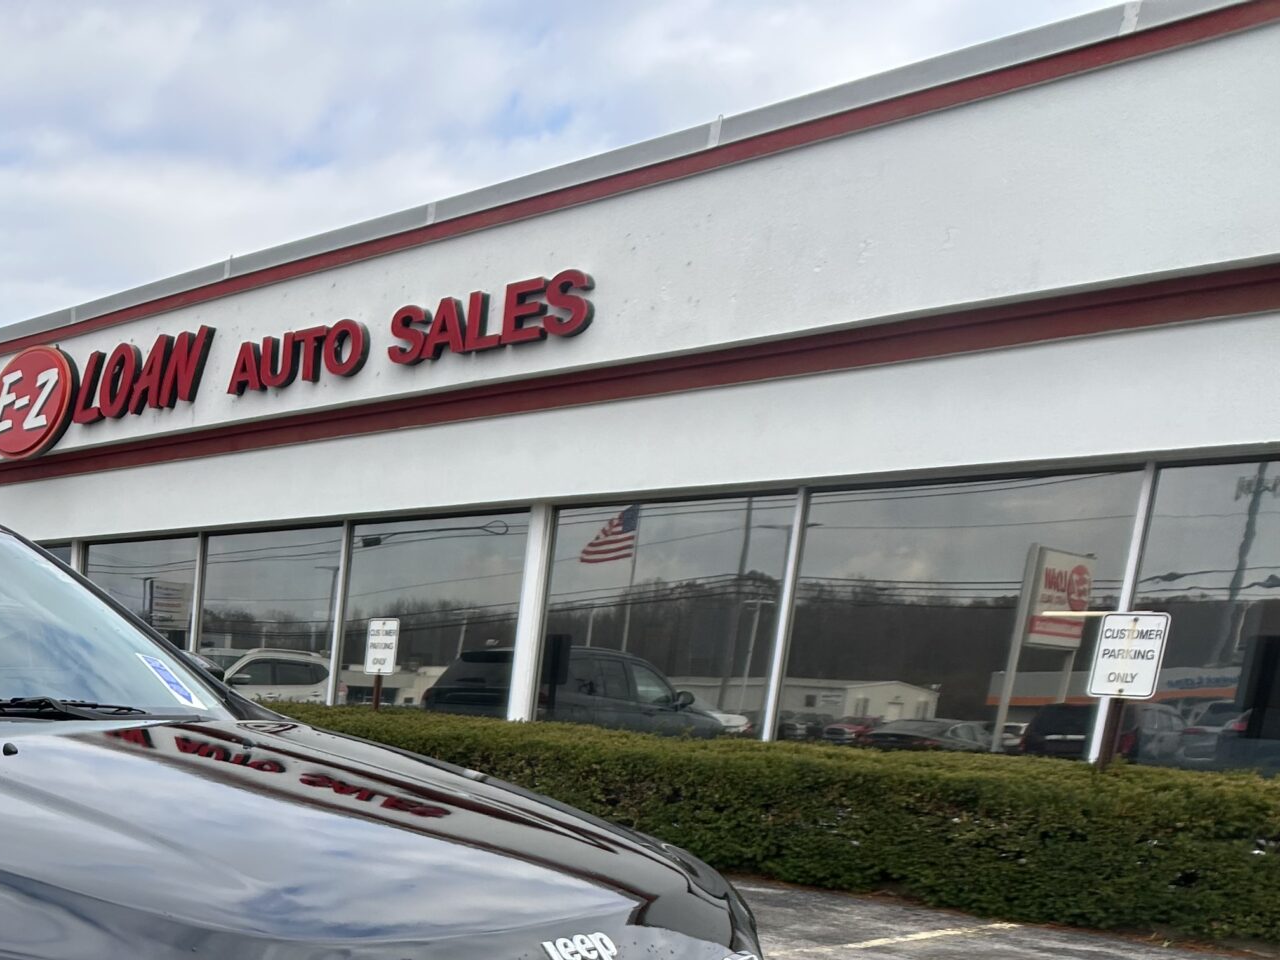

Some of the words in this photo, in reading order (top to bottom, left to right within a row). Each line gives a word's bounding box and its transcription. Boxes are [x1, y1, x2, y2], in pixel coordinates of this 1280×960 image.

[73, 325, 216, 425] LOAN
[227, 319, 371, 395] AUTO
[388, 269, 595, 366] SALES
[1104, 628, 1163, 640] CUSTOMER
[1102, 648, 1155, 660] PARKING
[1107, 672, 1138, 683] ONLY
